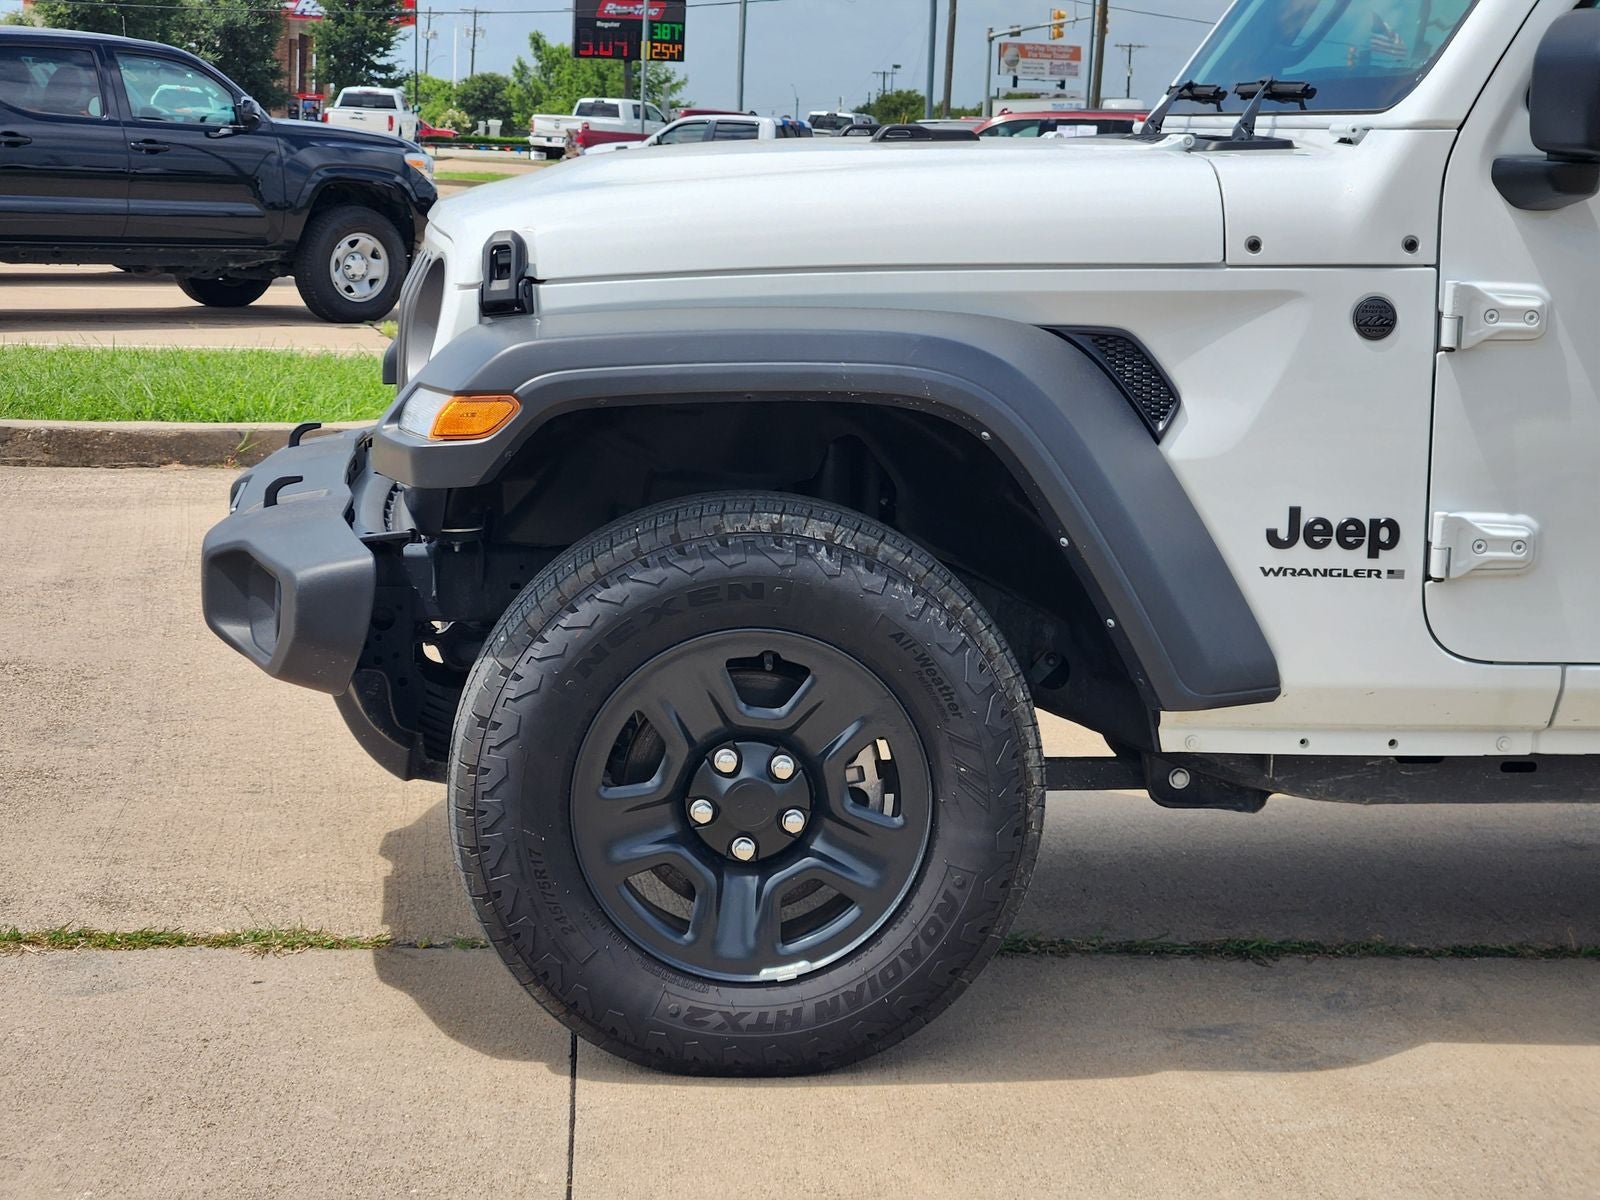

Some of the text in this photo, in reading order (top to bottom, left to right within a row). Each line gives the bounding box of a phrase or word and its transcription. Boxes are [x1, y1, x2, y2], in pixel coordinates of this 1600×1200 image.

[1265, 506, 1400, 559] Jeep
[1259, 566, 1382, 579] WRANGLER
[573, 582, 765, 679] NEXEN
[888, 631, 964, 719] All-Weather
[814, 889, 960, 1023] ROADIAN
[682, 1005, 803, 1033] HTX2
